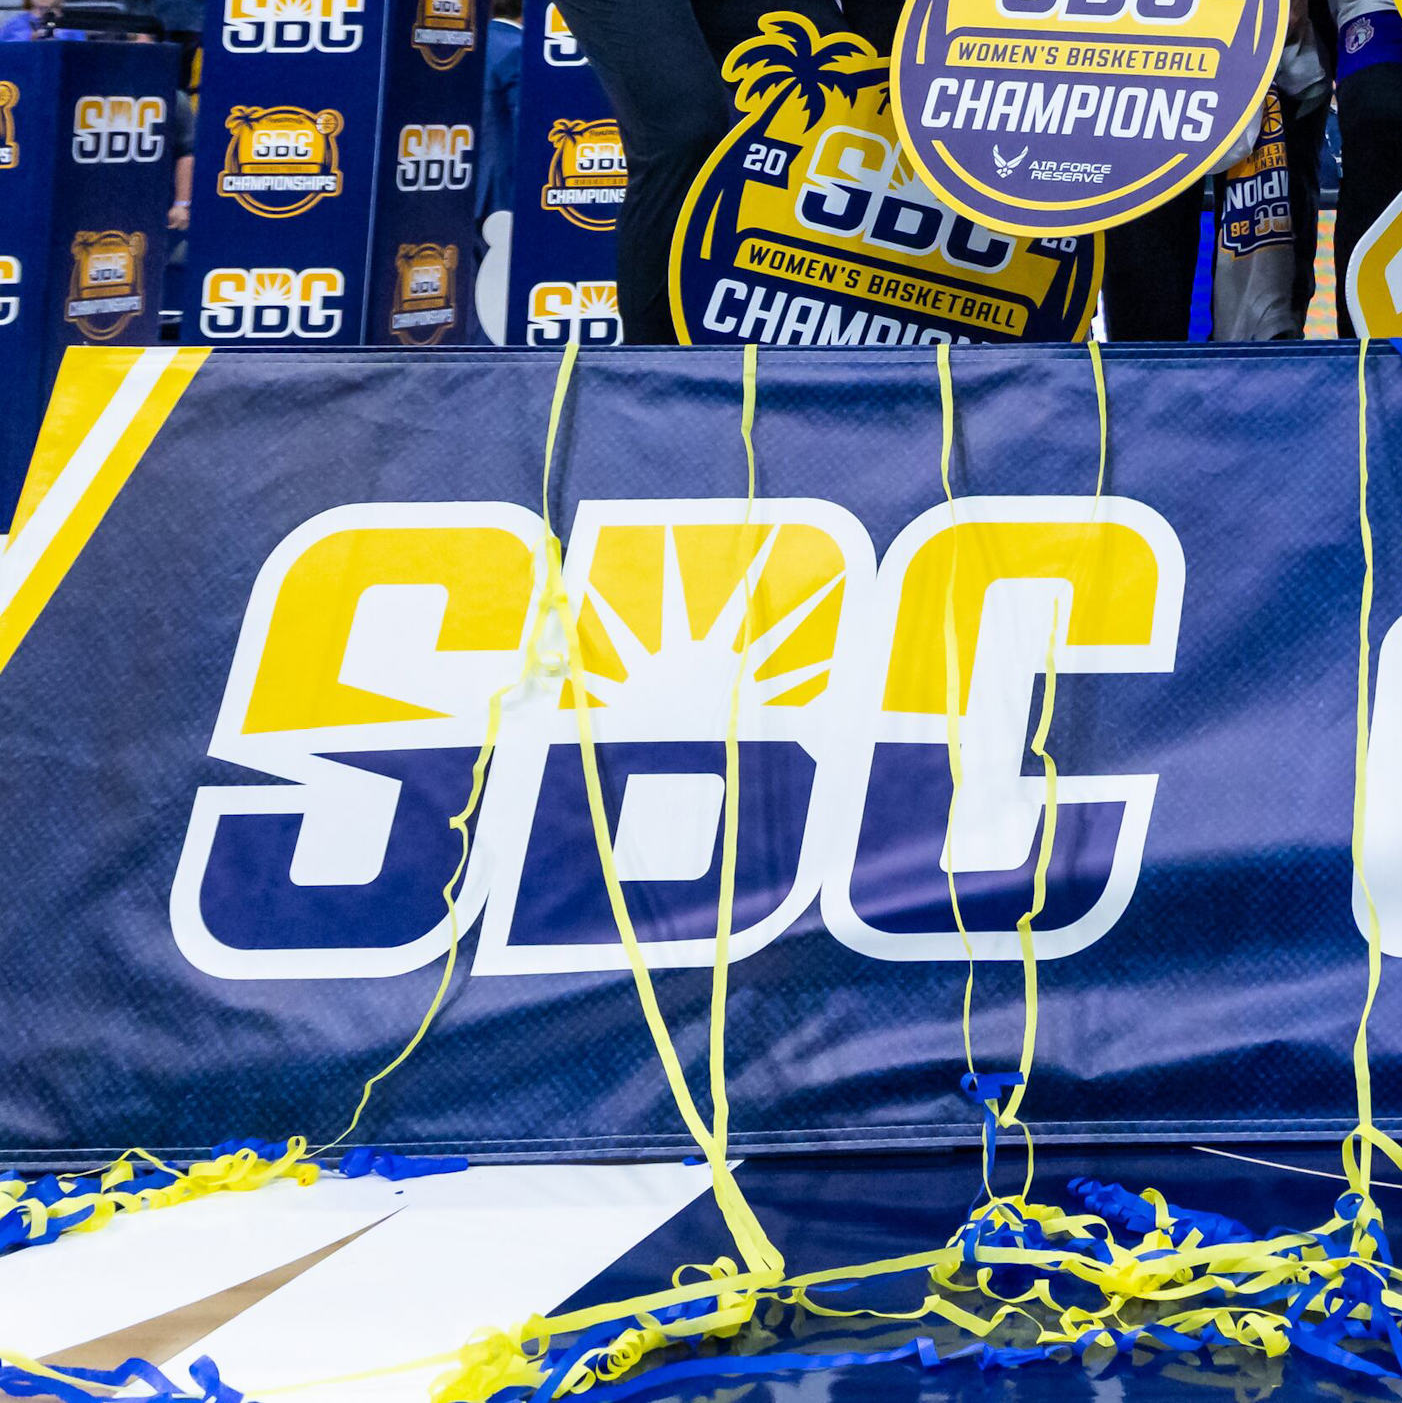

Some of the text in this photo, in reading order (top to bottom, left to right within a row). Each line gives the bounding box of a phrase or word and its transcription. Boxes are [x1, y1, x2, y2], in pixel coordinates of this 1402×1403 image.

[959, 43, 1207, 71] WOMEN'S BASKETBALL
[72, 96, 167, 164] SBC
[921, 77, 1218, 142] CHAMPIONS
[251, 129, 314, 160] SBC
[396, 124, 474, 191] SBC
[1029, 161, 1112, 174] AIR FORCE
[1031, 171, 1104, 183] RESERVE
[223, 174, 336, 193] CHAMPIONSHIPS
[201, 268, 345, 338] SBC
[750, 245, 1014, 328] WOMEN'S BASKETBALL
[167, 495, 1187, 979] SBC
